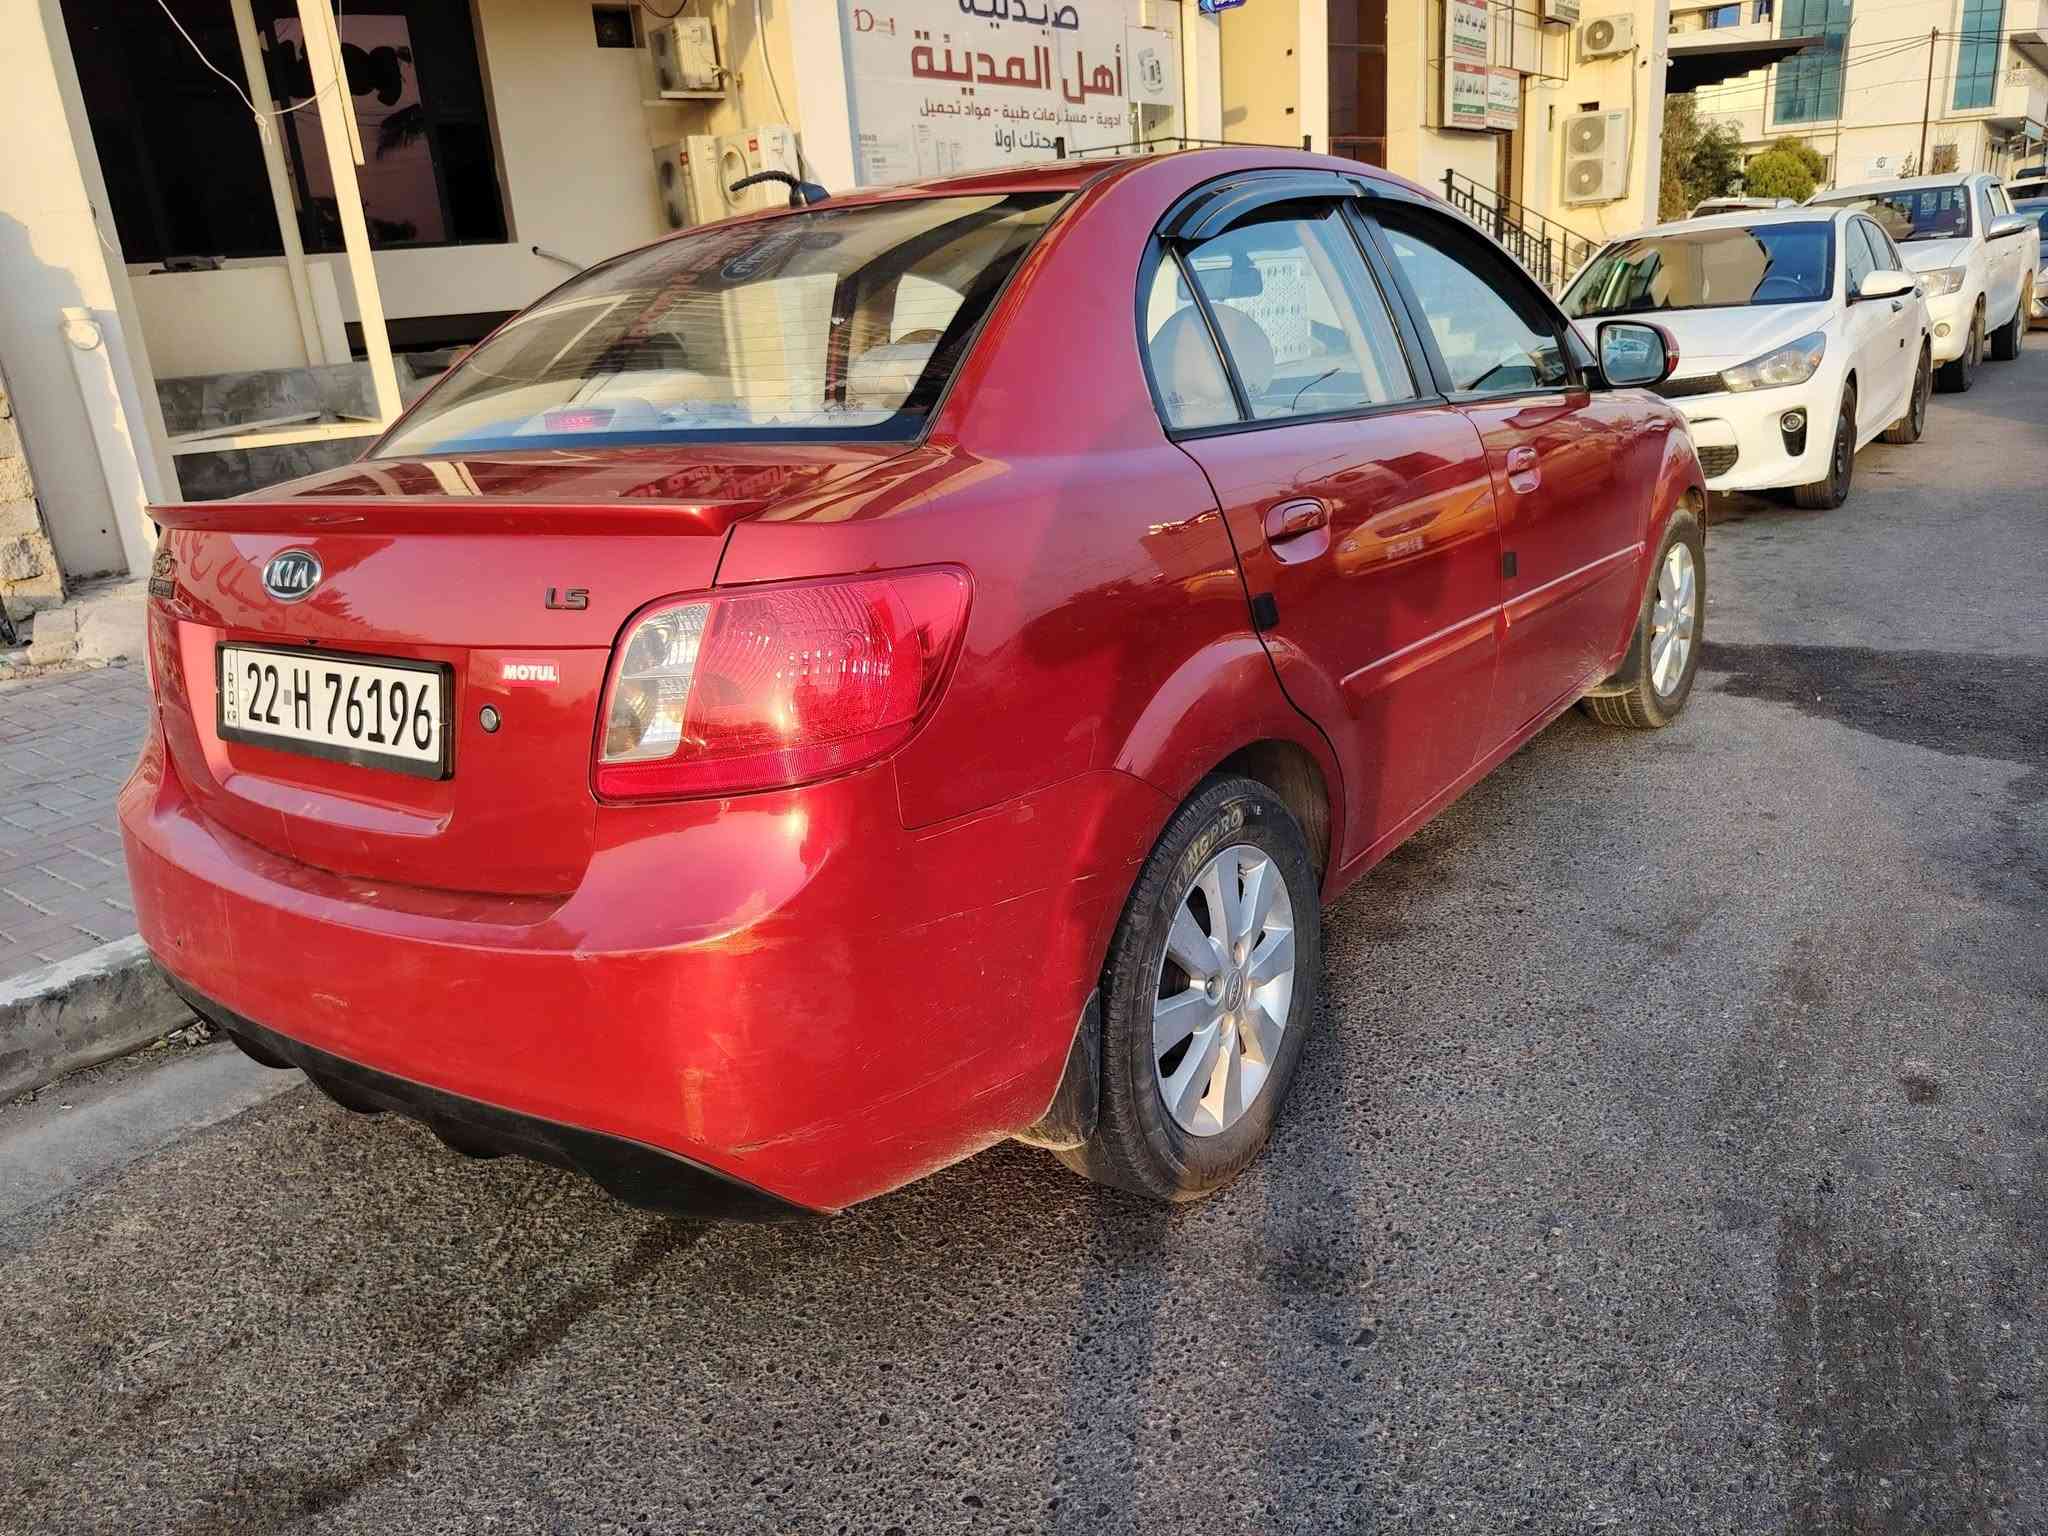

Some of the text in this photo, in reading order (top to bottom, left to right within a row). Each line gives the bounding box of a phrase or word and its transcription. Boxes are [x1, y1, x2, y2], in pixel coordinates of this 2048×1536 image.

[911, 30, 1052, 96] المدينة
[1062, 44, 1122, 104] أهل
[920, 98, 961, 119] تجميل
[964, 101, 991, 120] مواد
[1002, 104, 1030, 123] طبية
[270, 560, 308, 588] KIA
[545, 586, 590, 611] LS
[503, 664, 557, 681] MOTUL
[247, 661, 281, 725] 22
[325, 672, 433, 751] 76196
